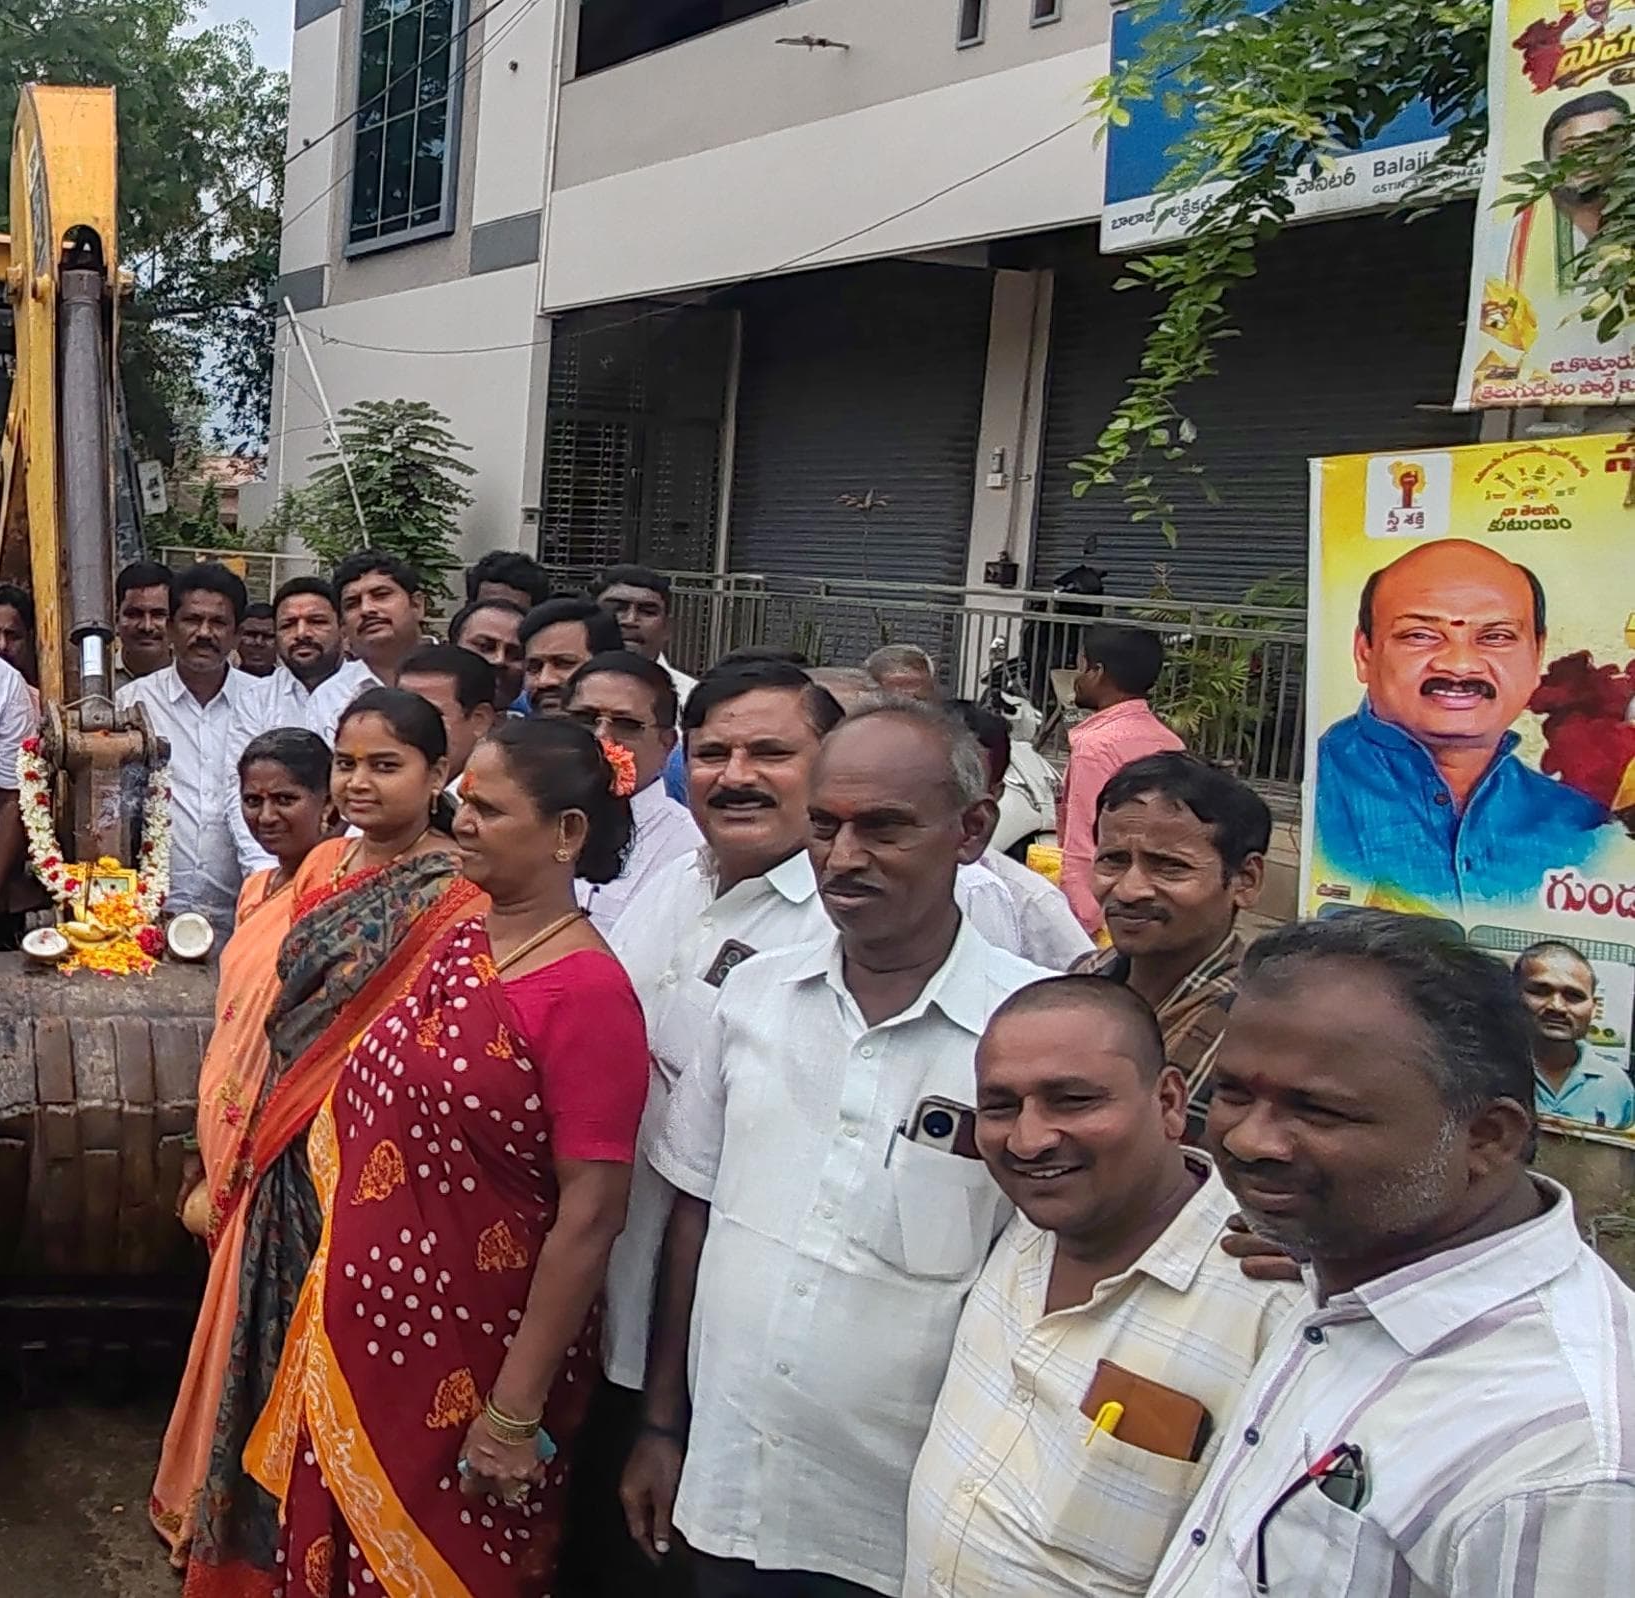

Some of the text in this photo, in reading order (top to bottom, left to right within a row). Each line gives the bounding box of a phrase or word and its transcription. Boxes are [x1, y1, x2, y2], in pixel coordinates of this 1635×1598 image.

[1373, 151, 1428, 178] Balaji
[1520, 503, 1559, 516] తెలుగు
[1487, 517, 1572, 533] కుటుంబం
[1547, 872, 1635, 919] గుండ
